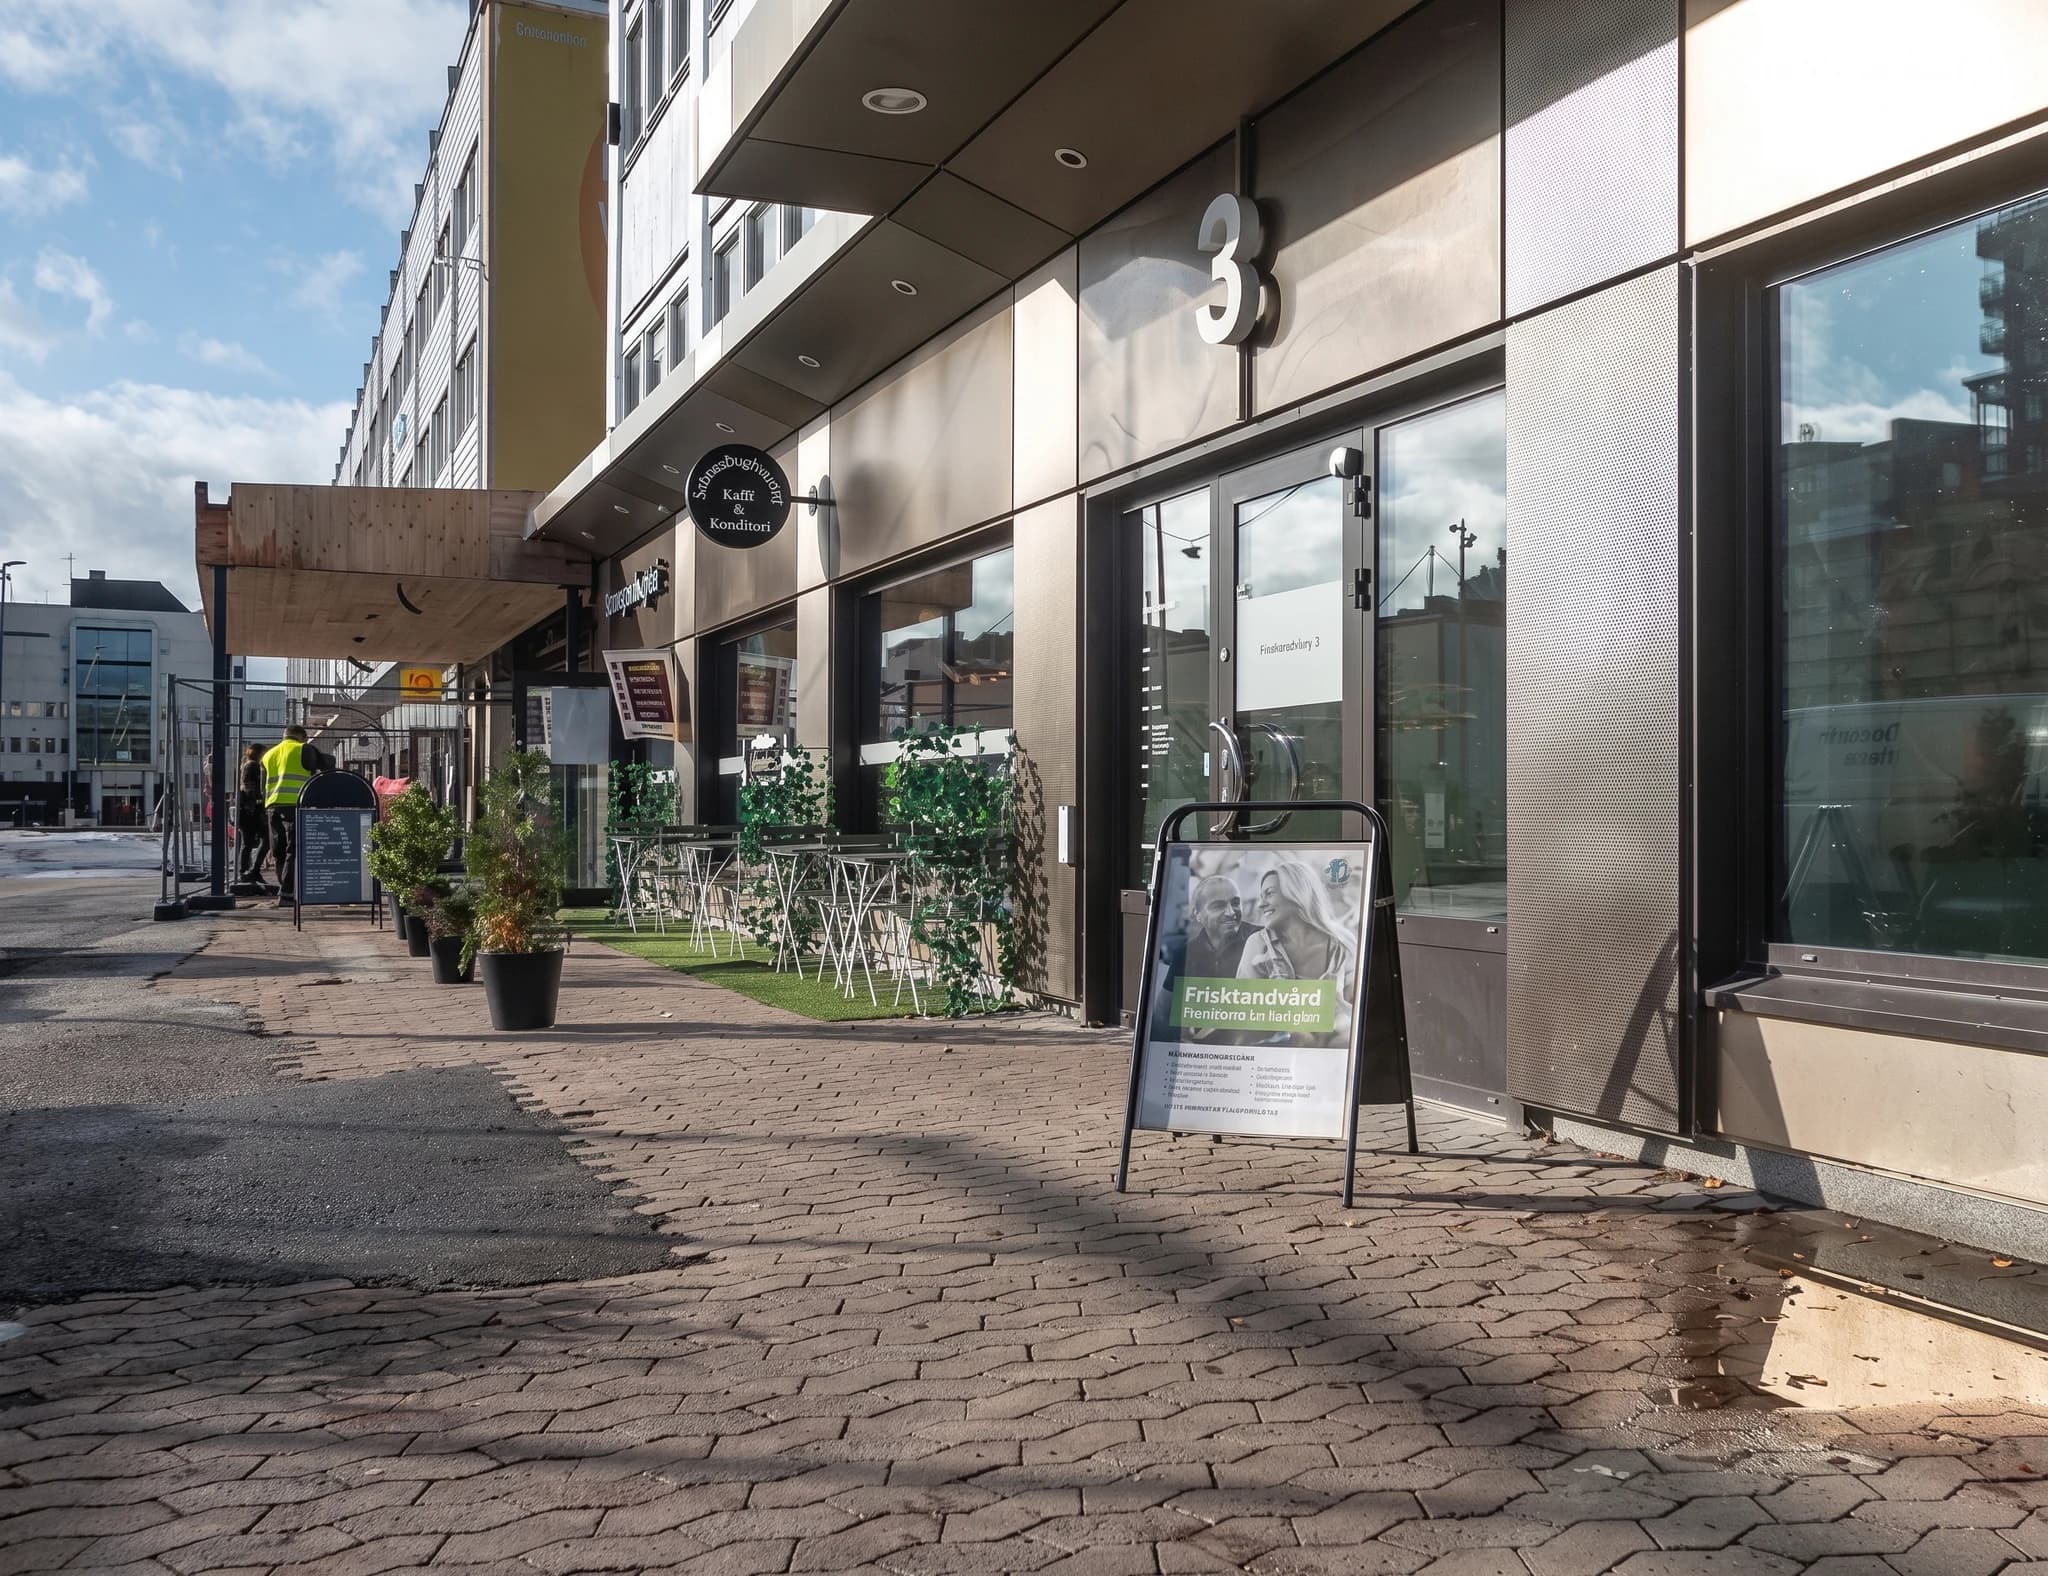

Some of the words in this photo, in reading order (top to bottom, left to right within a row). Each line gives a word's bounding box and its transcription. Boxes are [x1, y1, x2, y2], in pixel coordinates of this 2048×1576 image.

[1195, 193, 1253, 345] 3
[733, 503, 745, 515] &
[710, 517, 771, 533] Konditori
[1314, 635, 1321, 648] 3
[1184, 986, 1322, 1007] Frisktandvård
